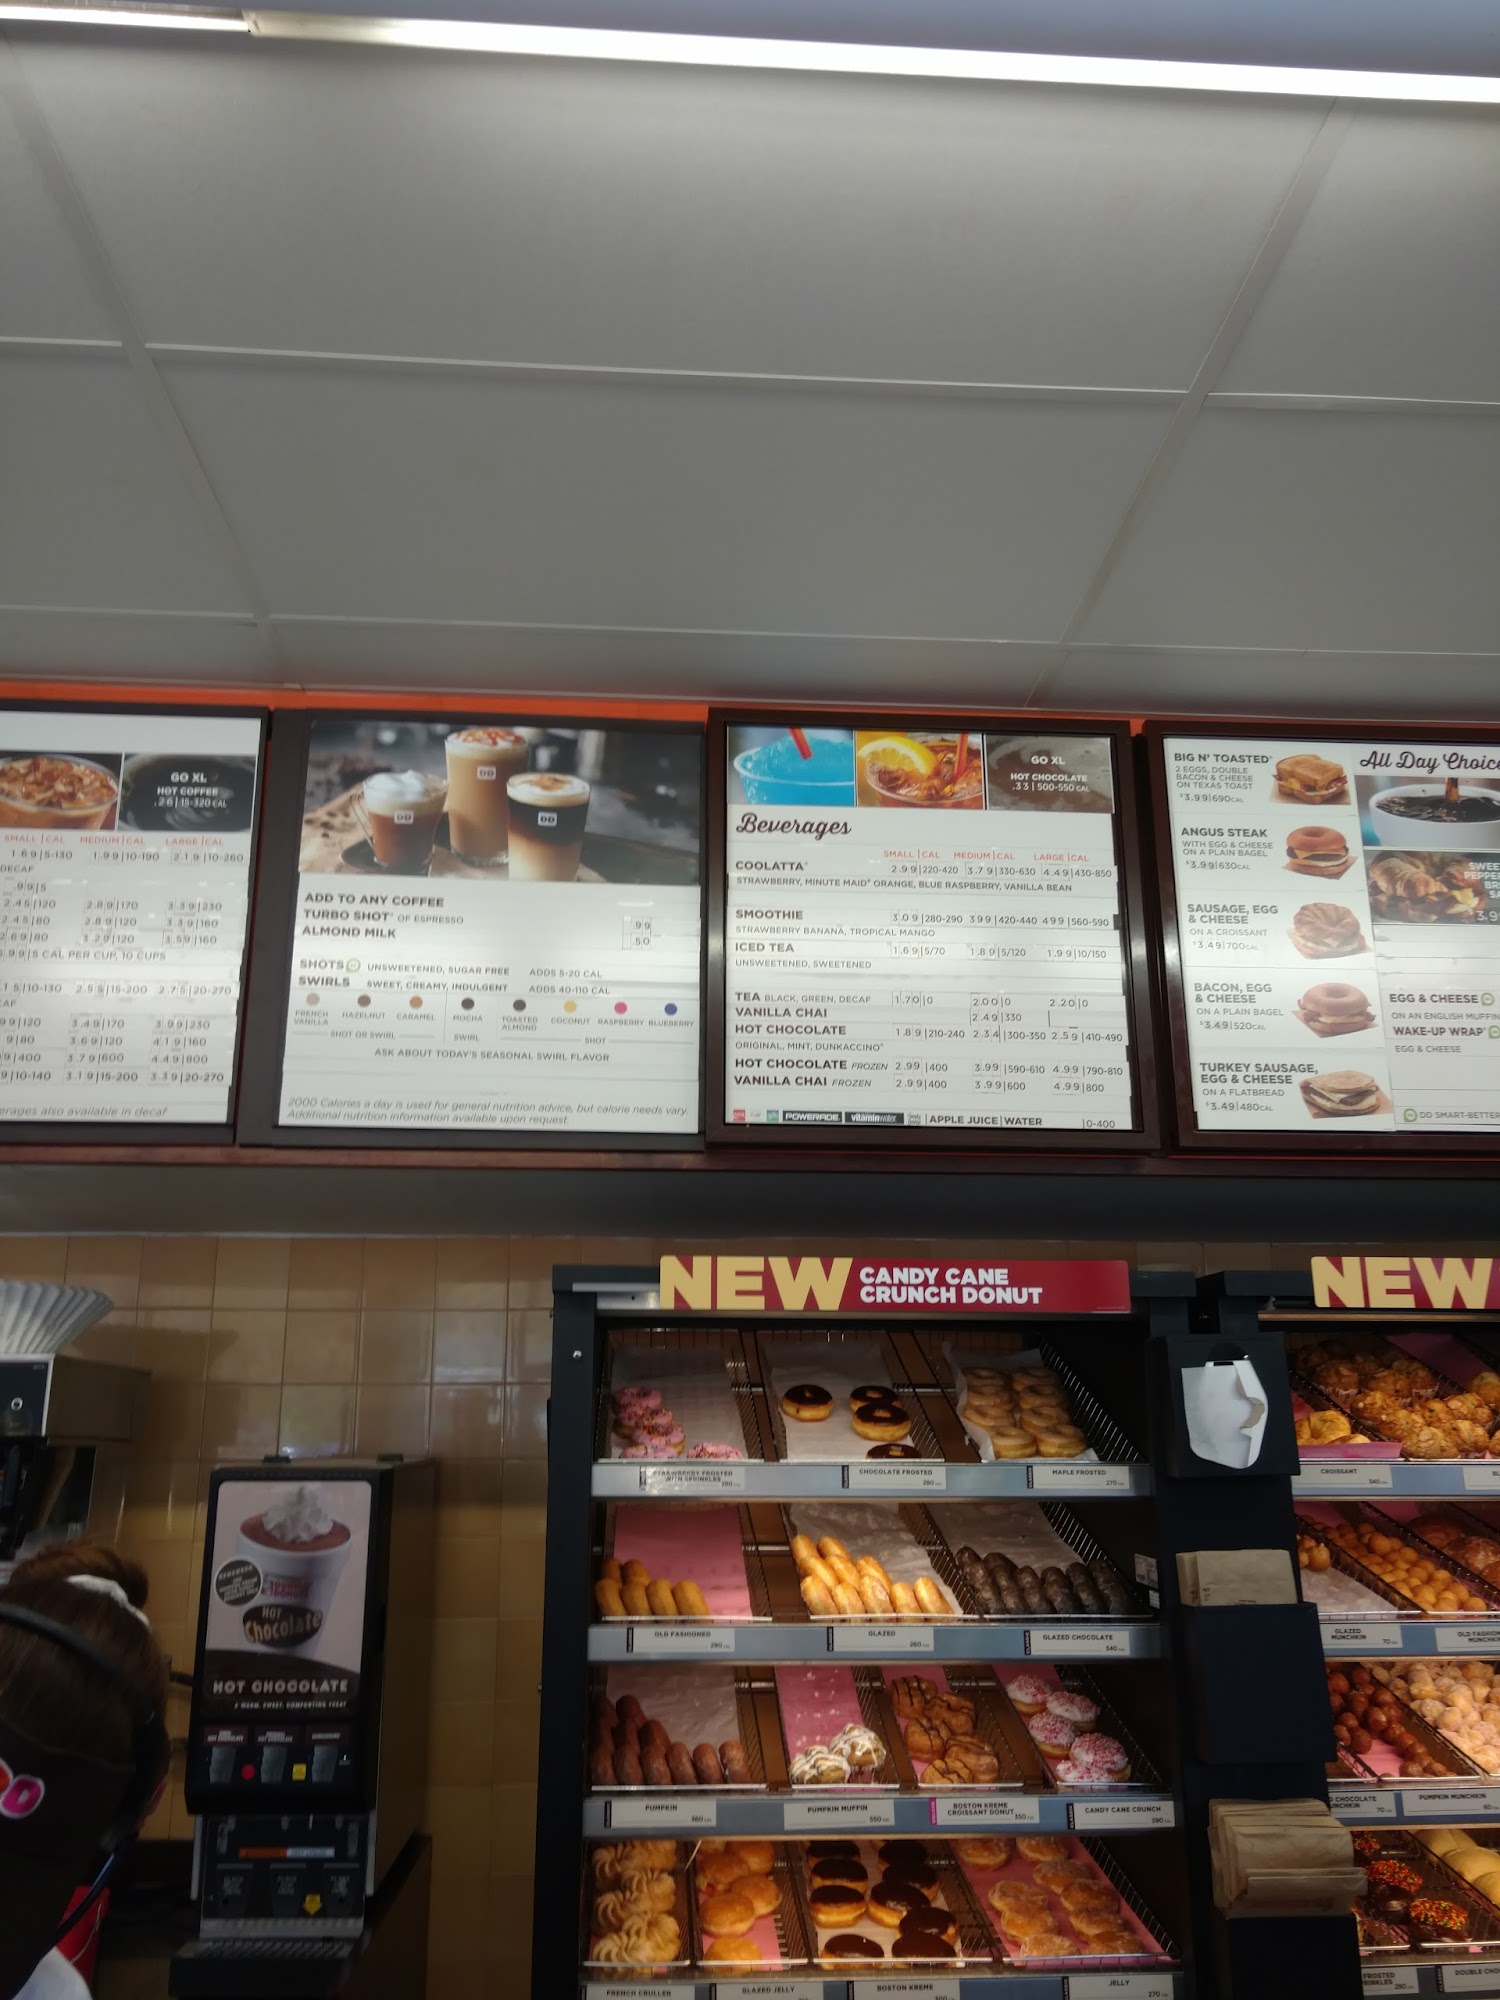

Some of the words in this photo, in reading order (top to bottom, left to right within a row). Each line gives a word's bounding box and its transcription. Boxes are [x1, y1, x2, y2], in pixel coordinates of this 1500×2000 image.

[1031, 756, 1048, 764] GO
[1051, 756, 1066, 765] XL
[1174, 753, 1195, 761] BIG
[1197, 753, 1210, 762] N'
[1213, 754, 1272, 763] TOASTED
[1360, 751, 1392, 770] All
[1396, 751, 1440, 774] Day
[1174, 766, 1181, 774] 2
[1182, 766, 1209, 776] EGGS,
[1211, 766, 1248, 775] DOUBLE
[170, 771, 189, 783] GO
[192, 772, 207, 783] XL
[1010, 772, 1030, 783] HOT
[1031, 773, 1087, 784] CHOCOLATE
[1175, 773, 1208, 782] BACON
[1209, 774, 1216, 782] &
[1218, 774, 1253, 783] CHEESE
[156, 786, 178, 797] HOT
[179, 786, 218, 796] COFFEE
[1175, 781, 1191, 789] ON
[1192, 781, 1222, 790] TEXAS
[1224, 782, 1252, 791] TOAST
[736, 812, 851, 839] Beverages
[1181, 827, 1224, 836] ANGUS
[1227, 828, 1267, 837] STEAK
[1181, 840, 1206, 849] WITH
[1208, 841, 1228, 849] EGG
[1229, 841, 1236, 849] &
[1238, 841, 1273, 850] CHEESE
[735, 861, 803, 870] COOLATTA
[736, 876, 802, 885] STRAWBERRY,
[804, 878, 841, 886] MINUTE
[873, 880, 916, 888] ORANGE,
[944, 881, 1002, 890] RASPBERRY,
[305, 892, 334, 902] ADD
[338, 893, 356, 904] TO
[359, 895, 388, 904] ANY
[391, 896, 444, 907] COFFEE
[303, 909, 350, 920] TURBO
[353, 911, 389, 921] SHOT
[735, 909, 803, 919] SMOOTHIE
[1187, 904, 1250, 916] SAUSAGE,
[1252, 905, 1278, 915] EGG
[413, 915, 464, 924] ESPRESSO
[1188, 914, 1196, 924] &
[1199, 914, 1248, 925] CHEESE
[302, 925, 361, 936] ALMOND
[364, 927, 396, 938] MILK
[735, 925, 801, 934] STRAWBERRY
[802, 925, 846, 935] BANANA,
[850, 927, 897, 936] TROPICAL
[734, 942, 765, 951] ICED
[768, 942, 794, 952] TEA
[299, 958, 347, 970] SHOTS
[367, 963, 445, 974] UNSWEETENED,
[448, 966, 482, 974] SUGAR
[484, 967, 509, 975] FREE
[298, 976, 350, 987] SWIRLS
[366, 980, 403, 989] SWEET,
[405, 981, 449, 991] CREAMY,
[451, 983, 507, 991] INDULGENT
[1193, 982, 1243, 994] BACON,
[1245, 983, 1272, 993] EGG
[735, 992, 760, 1001] TEA
[764, 994, 798, 1002] BLACK,
[801, 994, 836, 1003] GREEN,
[838, 995, 870, 1003] DECAF
[1194, 993, 1203, 1003] &
[1206, 993, 1256, 1004] CHEESE
[1389, 993, 1415, 1002] EGG
[1418, 993, 1426, 1002] &
[1429, 994, 1478, 1003] CHEESE
[735, 1007, 791, 1017] VANILLA
[795, 1008, 827, 1017] CHAI
[734, 1024, 762, 1033] HOT
[766, 1024, 846, 1035] CHOCOLATE
[1393, 1026, 1446, 1036] WAKE-UP
[1448, 1026, 1484, 1036] WRAP
[734, 1058, 762, 1067] HOT
[766, 1059, 847, 1069] CHOCOLATE
[850, 1062, 888, 1070] FROZEN
[1199, 1062, 1250, 1073] TURKEY
[1254, 1062, 1318, 1075] SAUSAGE,
[734, 1075, 790, 1085] VANILLA
[794, 1076, 827, 1086] CHAI
[831, 1078, 872, 1087] FROZEN
[1200, 1074, 1228, 1083] EGG
[1230, 1074, 1239, 1083] &
[1242, 1074, 1292, 1084] CHEESE
[930, 1116, 964, 1125] APPLE
[860, 1266, 938, 1285] CANDY
[945, 1268, 1008, 1286] CANE
[660, 1255, 853, 1311] NEW
[1311, 1256, 1493, 1310] NEW
[860, 1286, 960, 1304] CRUNCH
[962, 1288, 1042, 1304] DONUT
[213, 1679, 246, 1694] HOT
[252, 1679, 348, 1694] CHOCOLATE
